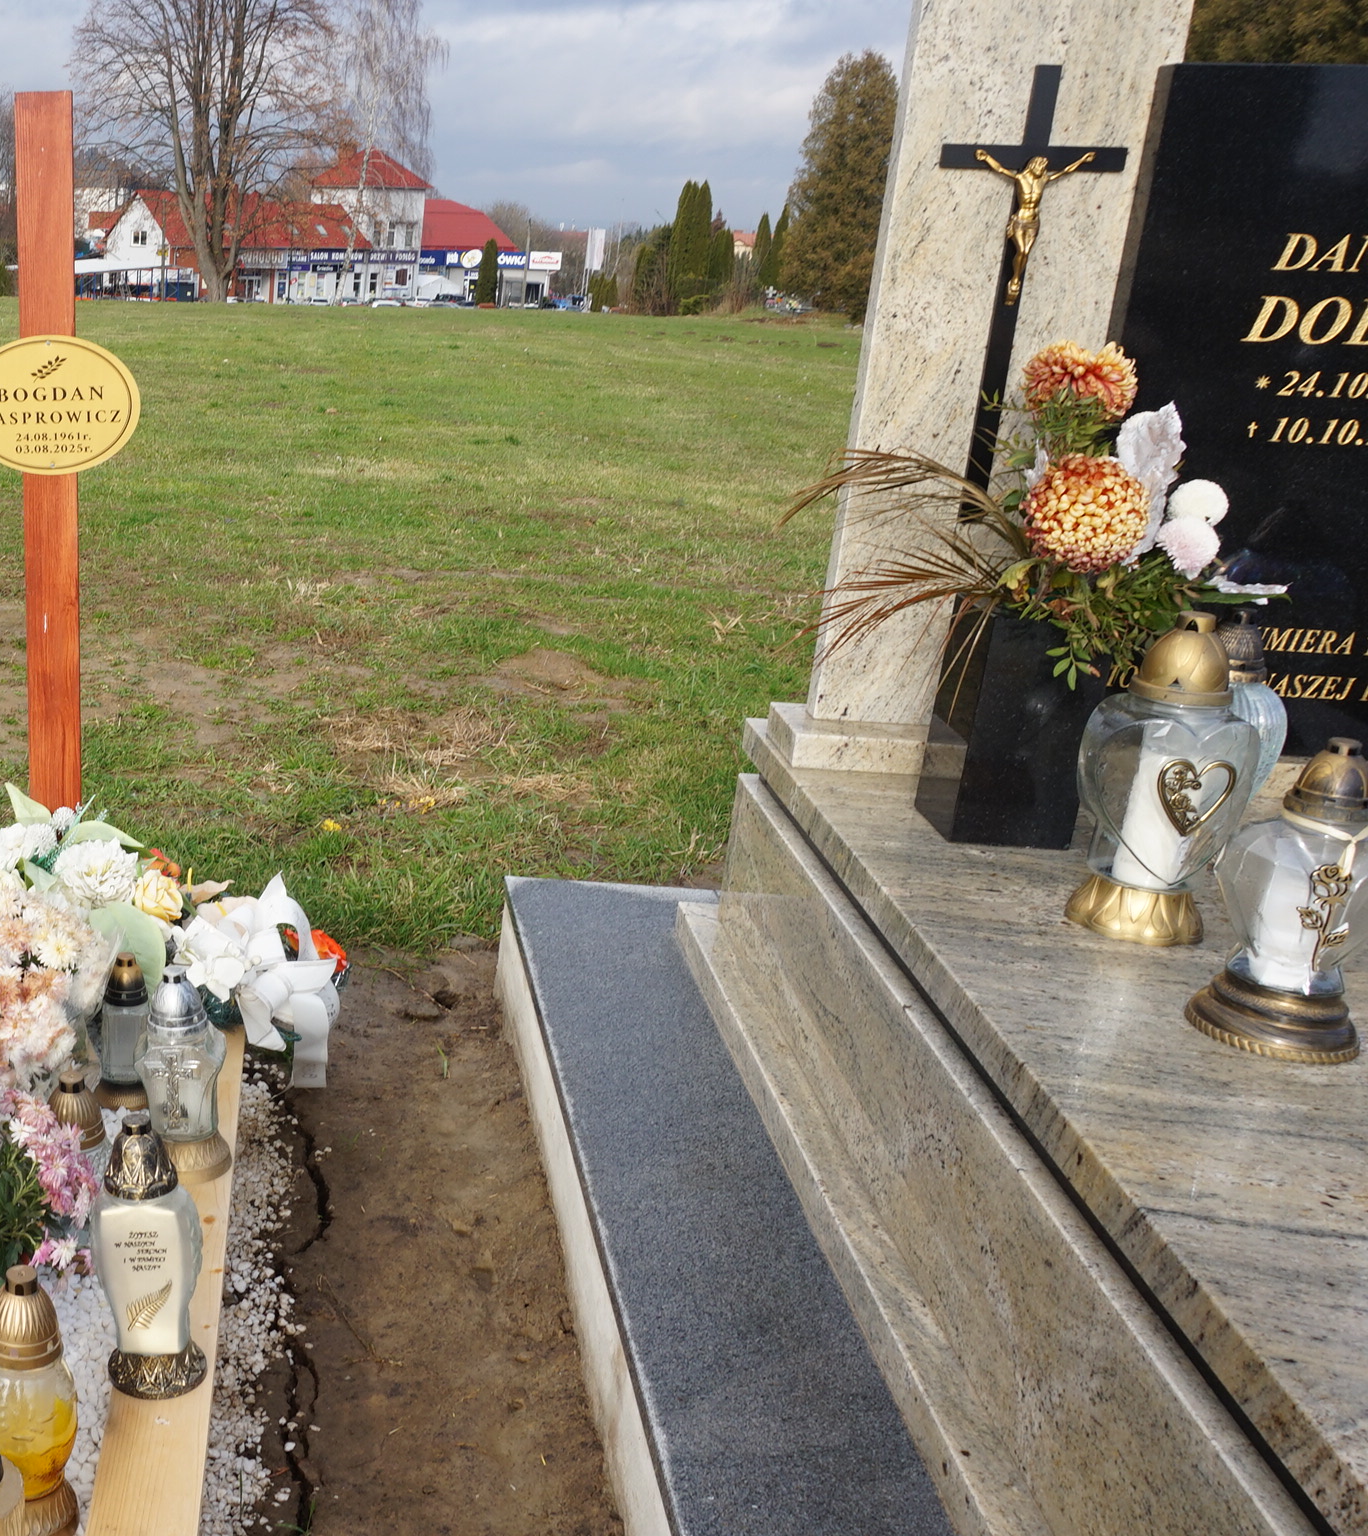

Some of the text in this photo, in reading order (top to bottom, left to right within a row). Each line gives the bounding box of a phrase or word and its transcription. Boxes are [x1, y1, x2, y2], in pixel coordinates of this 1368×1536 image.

[310, 252, 328, 261] SALON
[496, 252, 527, 265] ÓWKA
[1267, 417, 1368, 446] 10.10.
[15, 432, 91, 442] 24.08.1961r.
[15, 444, 93, 454] 03.08.2025r.
